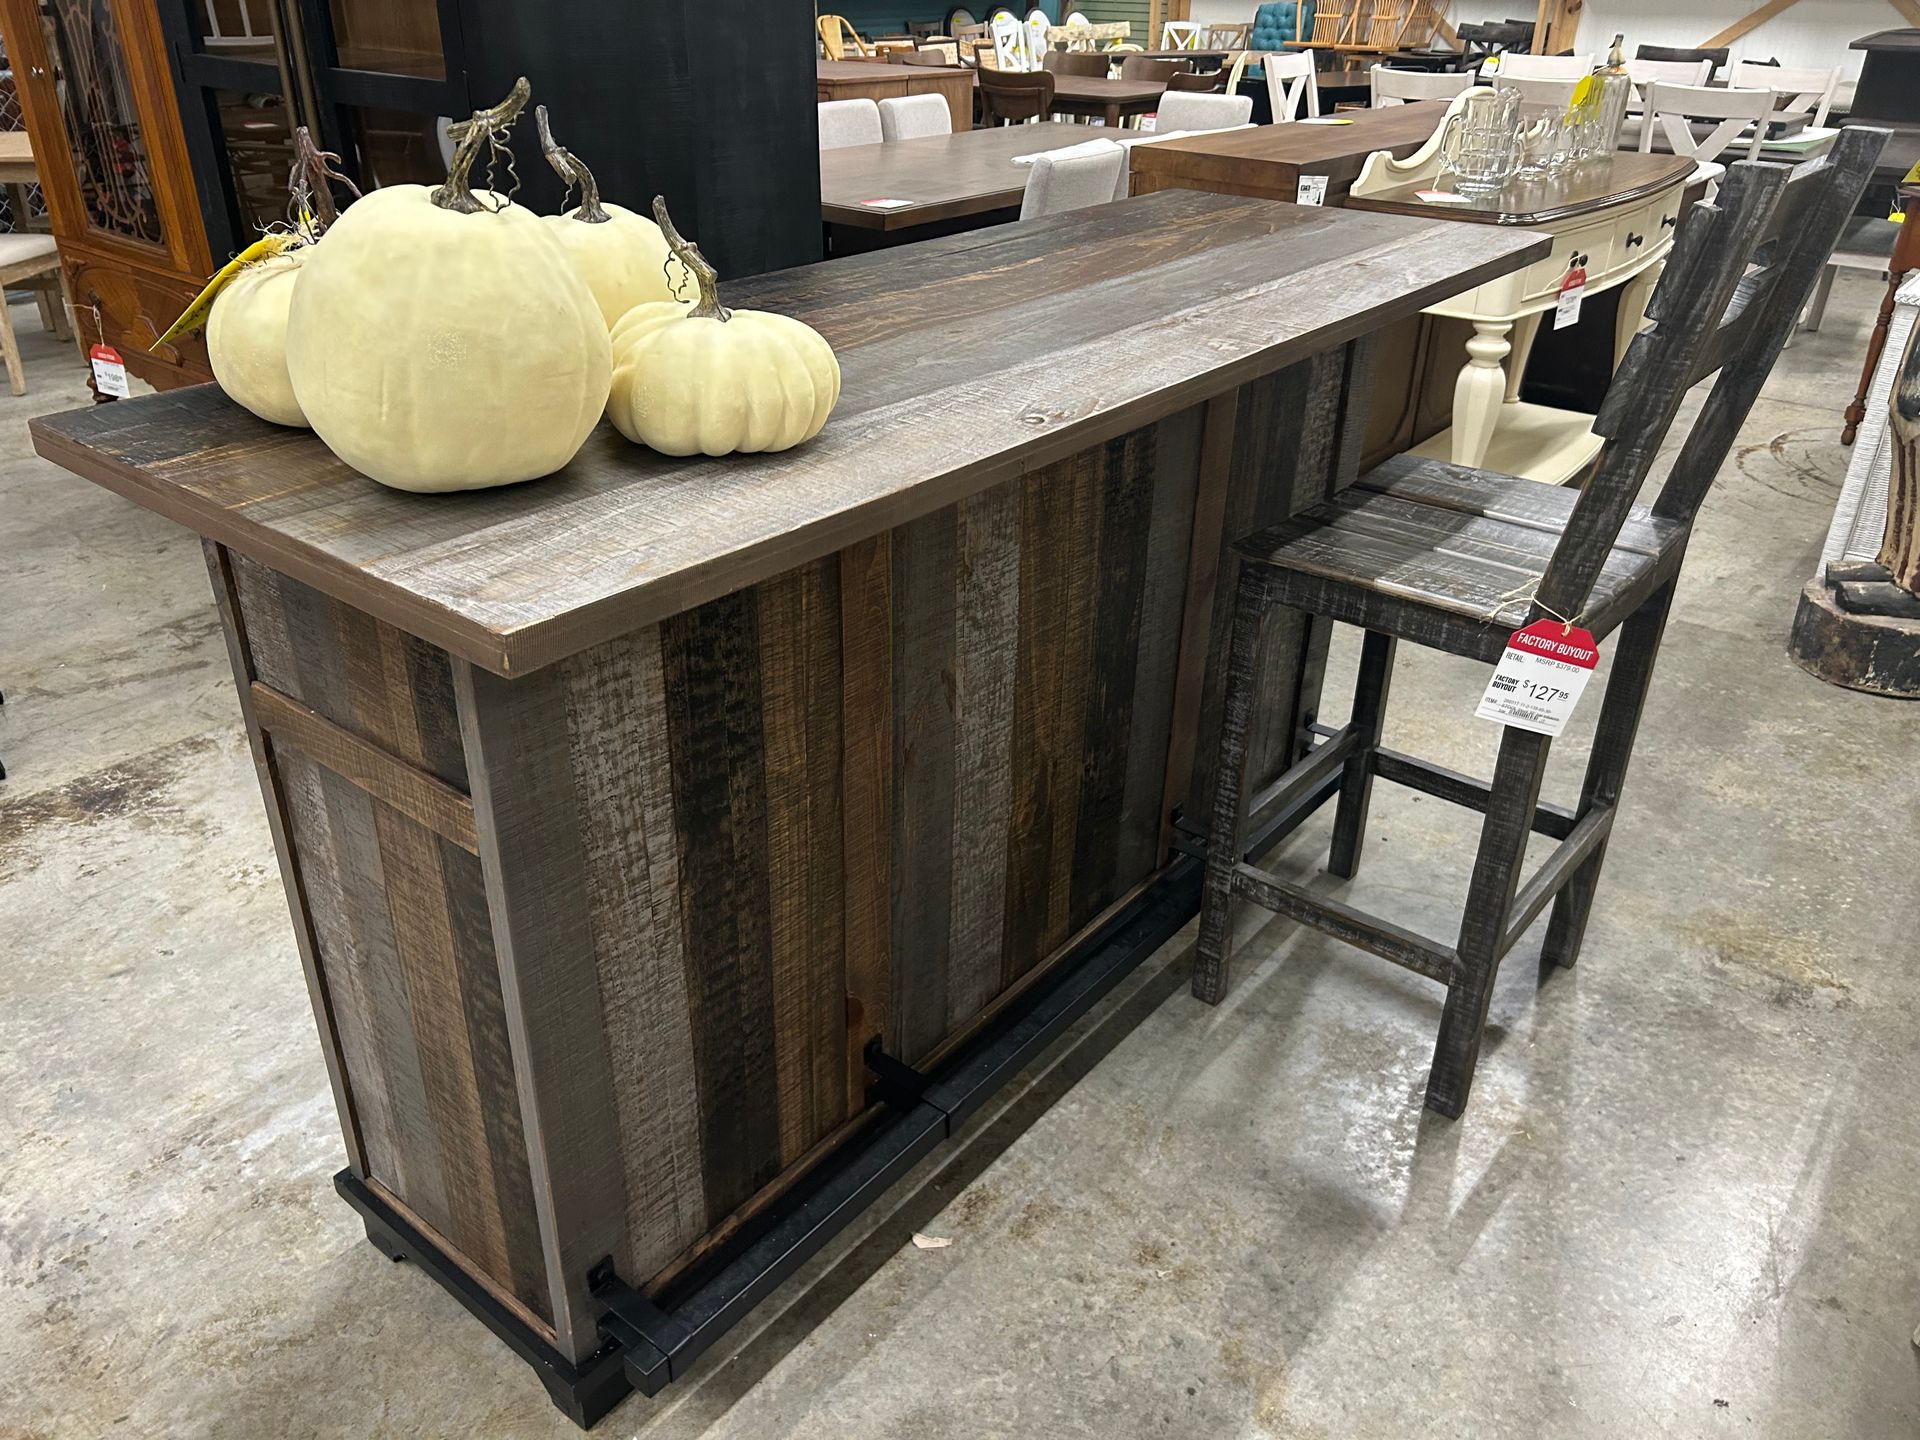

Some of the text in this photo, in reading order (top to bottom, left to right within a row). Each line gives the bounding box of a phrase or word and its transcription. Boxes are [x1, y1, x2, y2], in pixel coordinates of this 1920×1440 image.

[1517, 633, 1593, 661] FACTORY BUYOUT
[1536, 657, 1556, 667] MSRP
[1556, 663, 1580, 673] $379.00
[1496, 674, 1519, 685] FACTORY
[1492, 681, 1516, 693] BUYOUT
